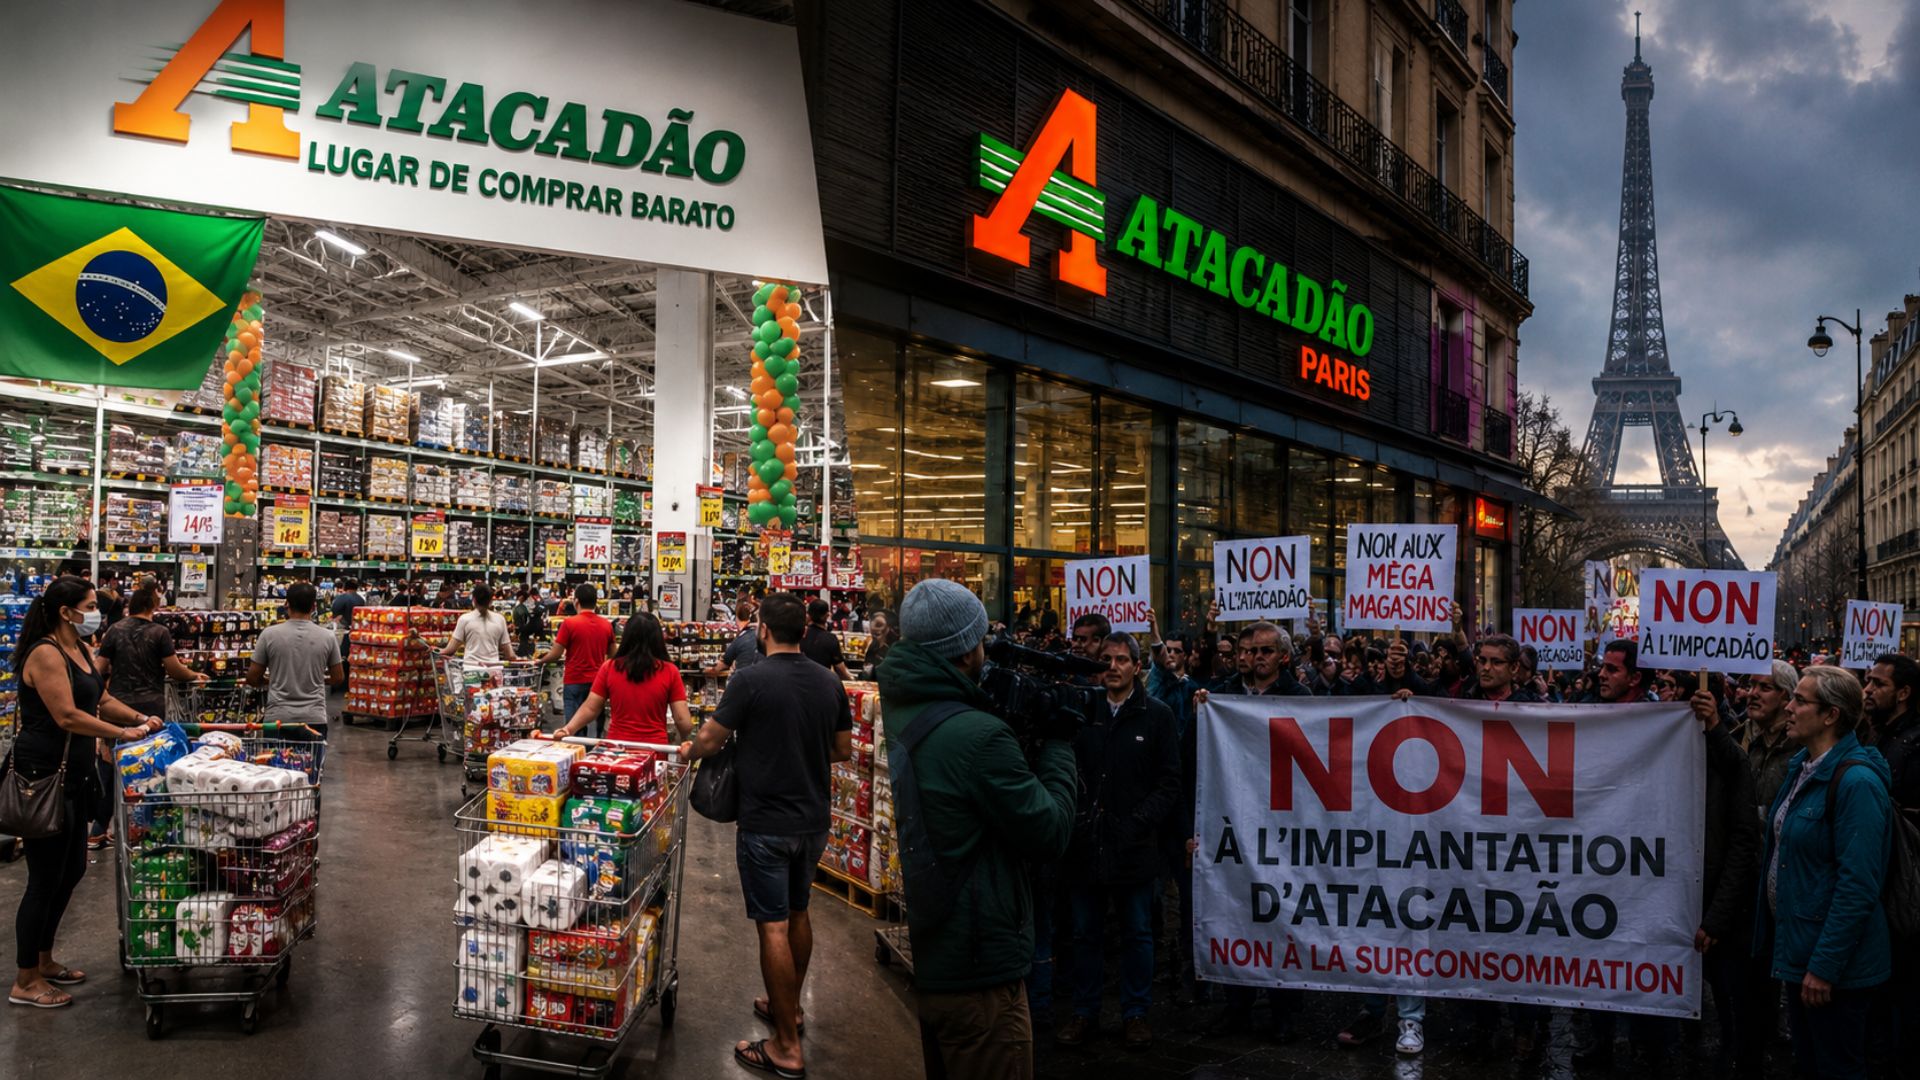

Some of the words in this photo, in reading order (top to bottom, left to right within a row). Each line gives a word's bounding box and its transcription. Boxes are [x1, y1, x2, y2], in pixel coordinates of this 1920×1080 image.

[315, 61, 746, 186] ATACADÃO
[308, 140, 418, 187] LUGAR
[430, 160, 469, 194] DE
[479, 168, 623, 219] COMPRAR
[630, 191, 736, 232] BARATO
[1115, 194, 1375, 357] ATACADÃO
[1300, 345, 1371, 401] PARIS
[1076, 563, 1136, 599] NON
[1227, 544, 1296, 584] NON
[1348, 593, 1450, 622] MAGASINS
[1520, 614, 1576, 643] NON
[1653, 579, 1759, 625] NON
[1851, 607, 1896, 638] NON
[1641, 626, 1655, 655] À
[1268, 715, 1575, 819] NON
[1213, 815, 1243, 865] À
[1257, 826, 1666, 878] L'IMPLANTATION
[1250, 880, 1618, 941] D'ATACADÃO
[1210, 937, 1273, 969] NON
[1282, 934, 1303, 970] À
[1311, 944, 1346, 973] LA
[1355, 945, 1685, 997] SURCONSOMMATION
